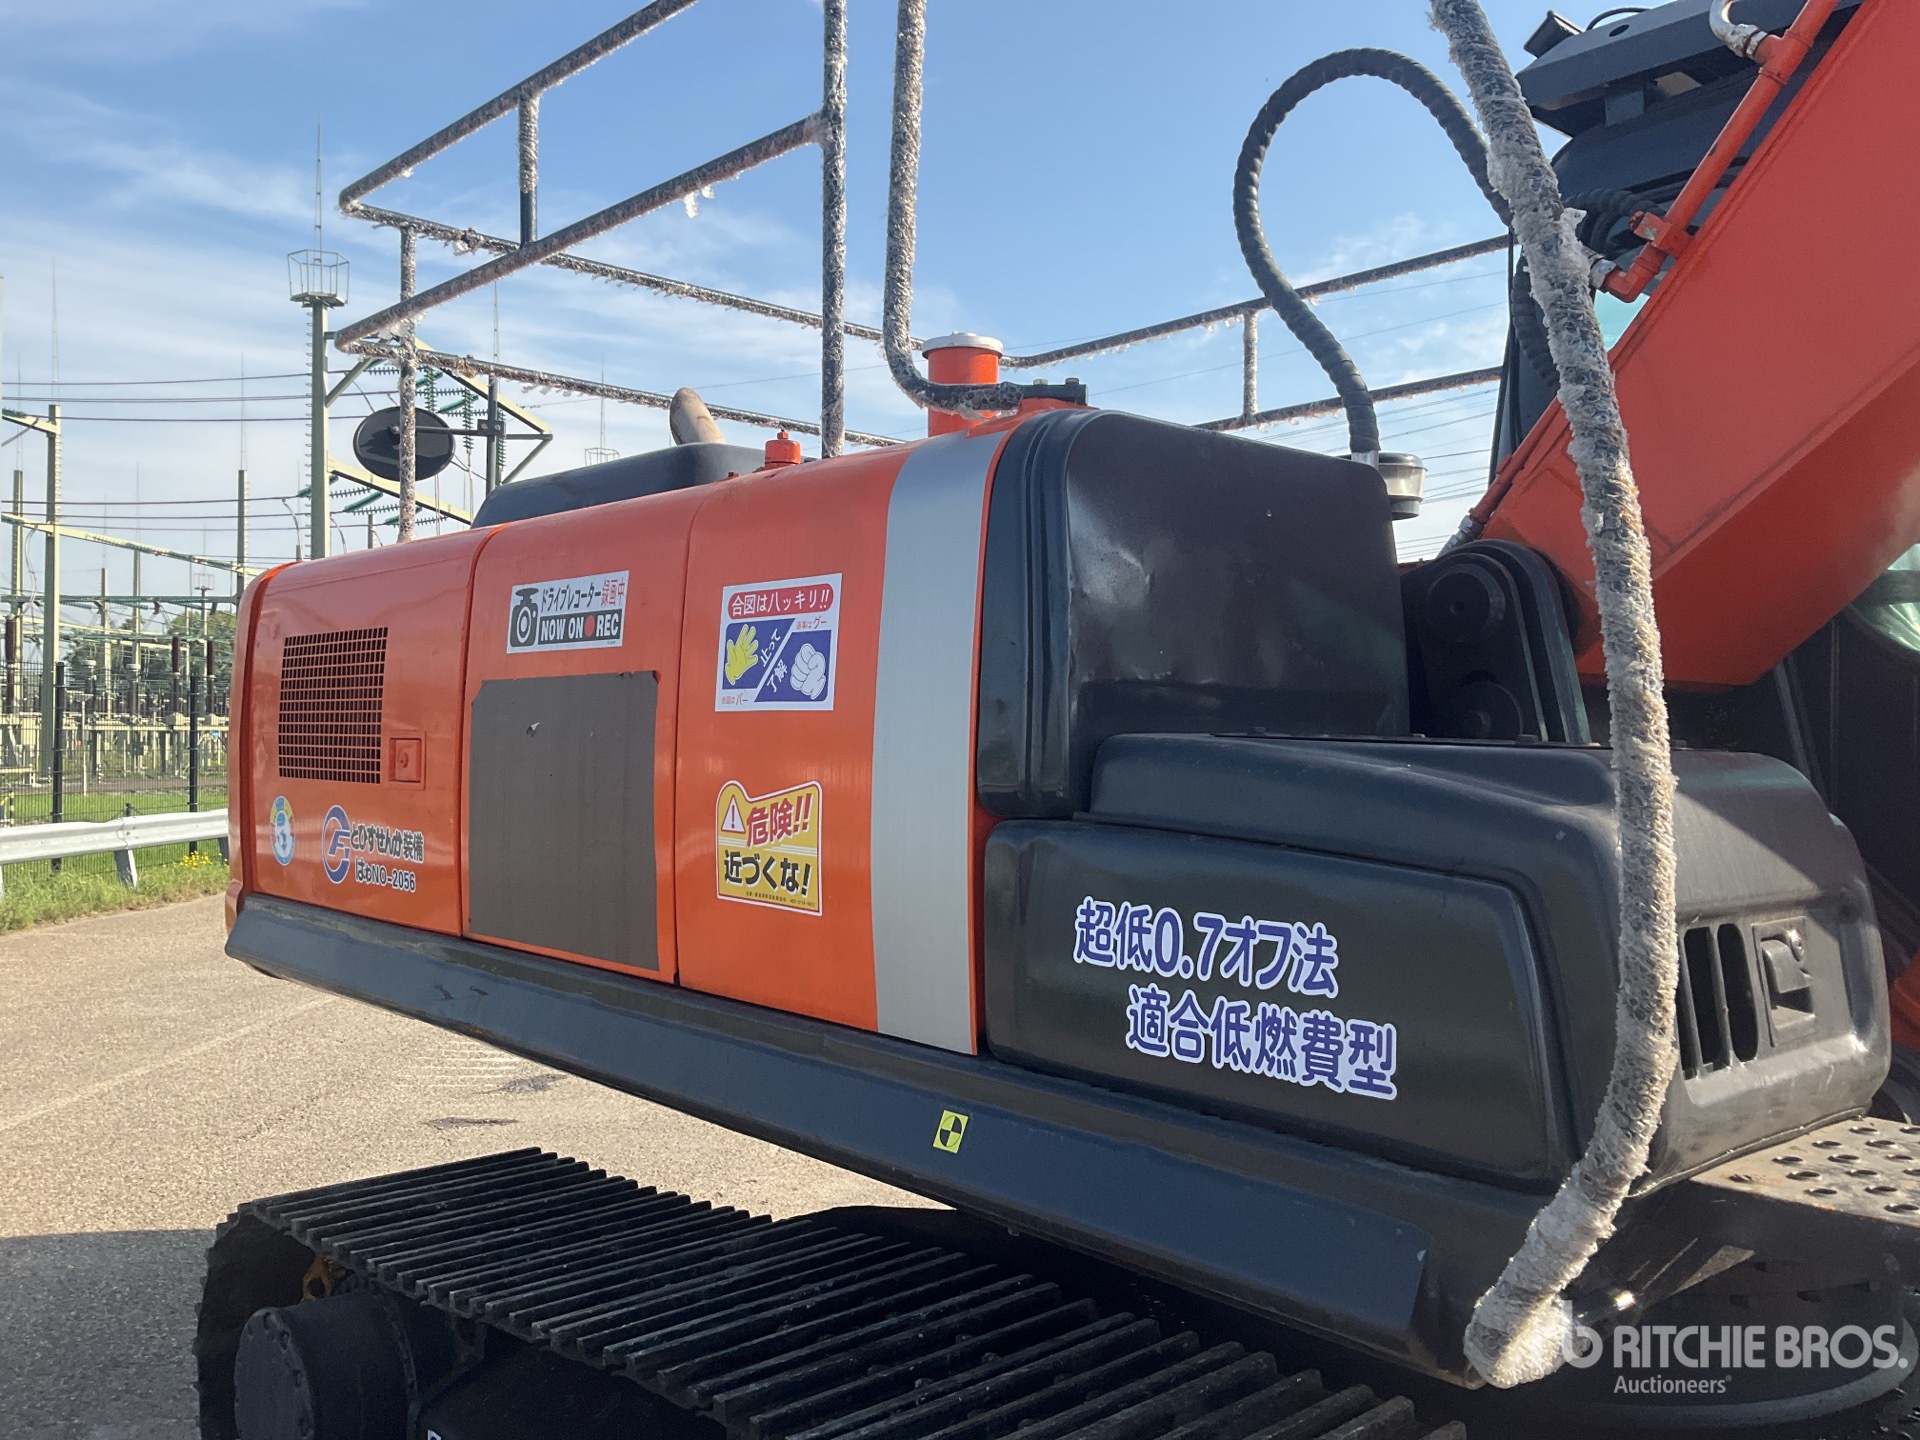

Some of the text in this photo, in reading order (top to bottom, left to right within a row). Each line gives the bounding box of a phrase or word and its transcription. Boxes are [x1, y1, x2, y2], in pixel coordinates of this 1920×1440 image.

[541, 612, 619, 641] NOW ON REC
[746, 793, 813, 847] 危険!!
[724, 849, 812, 896] 近づくな!
[1127, 985, 1396, 1097] 適合低燃費型
